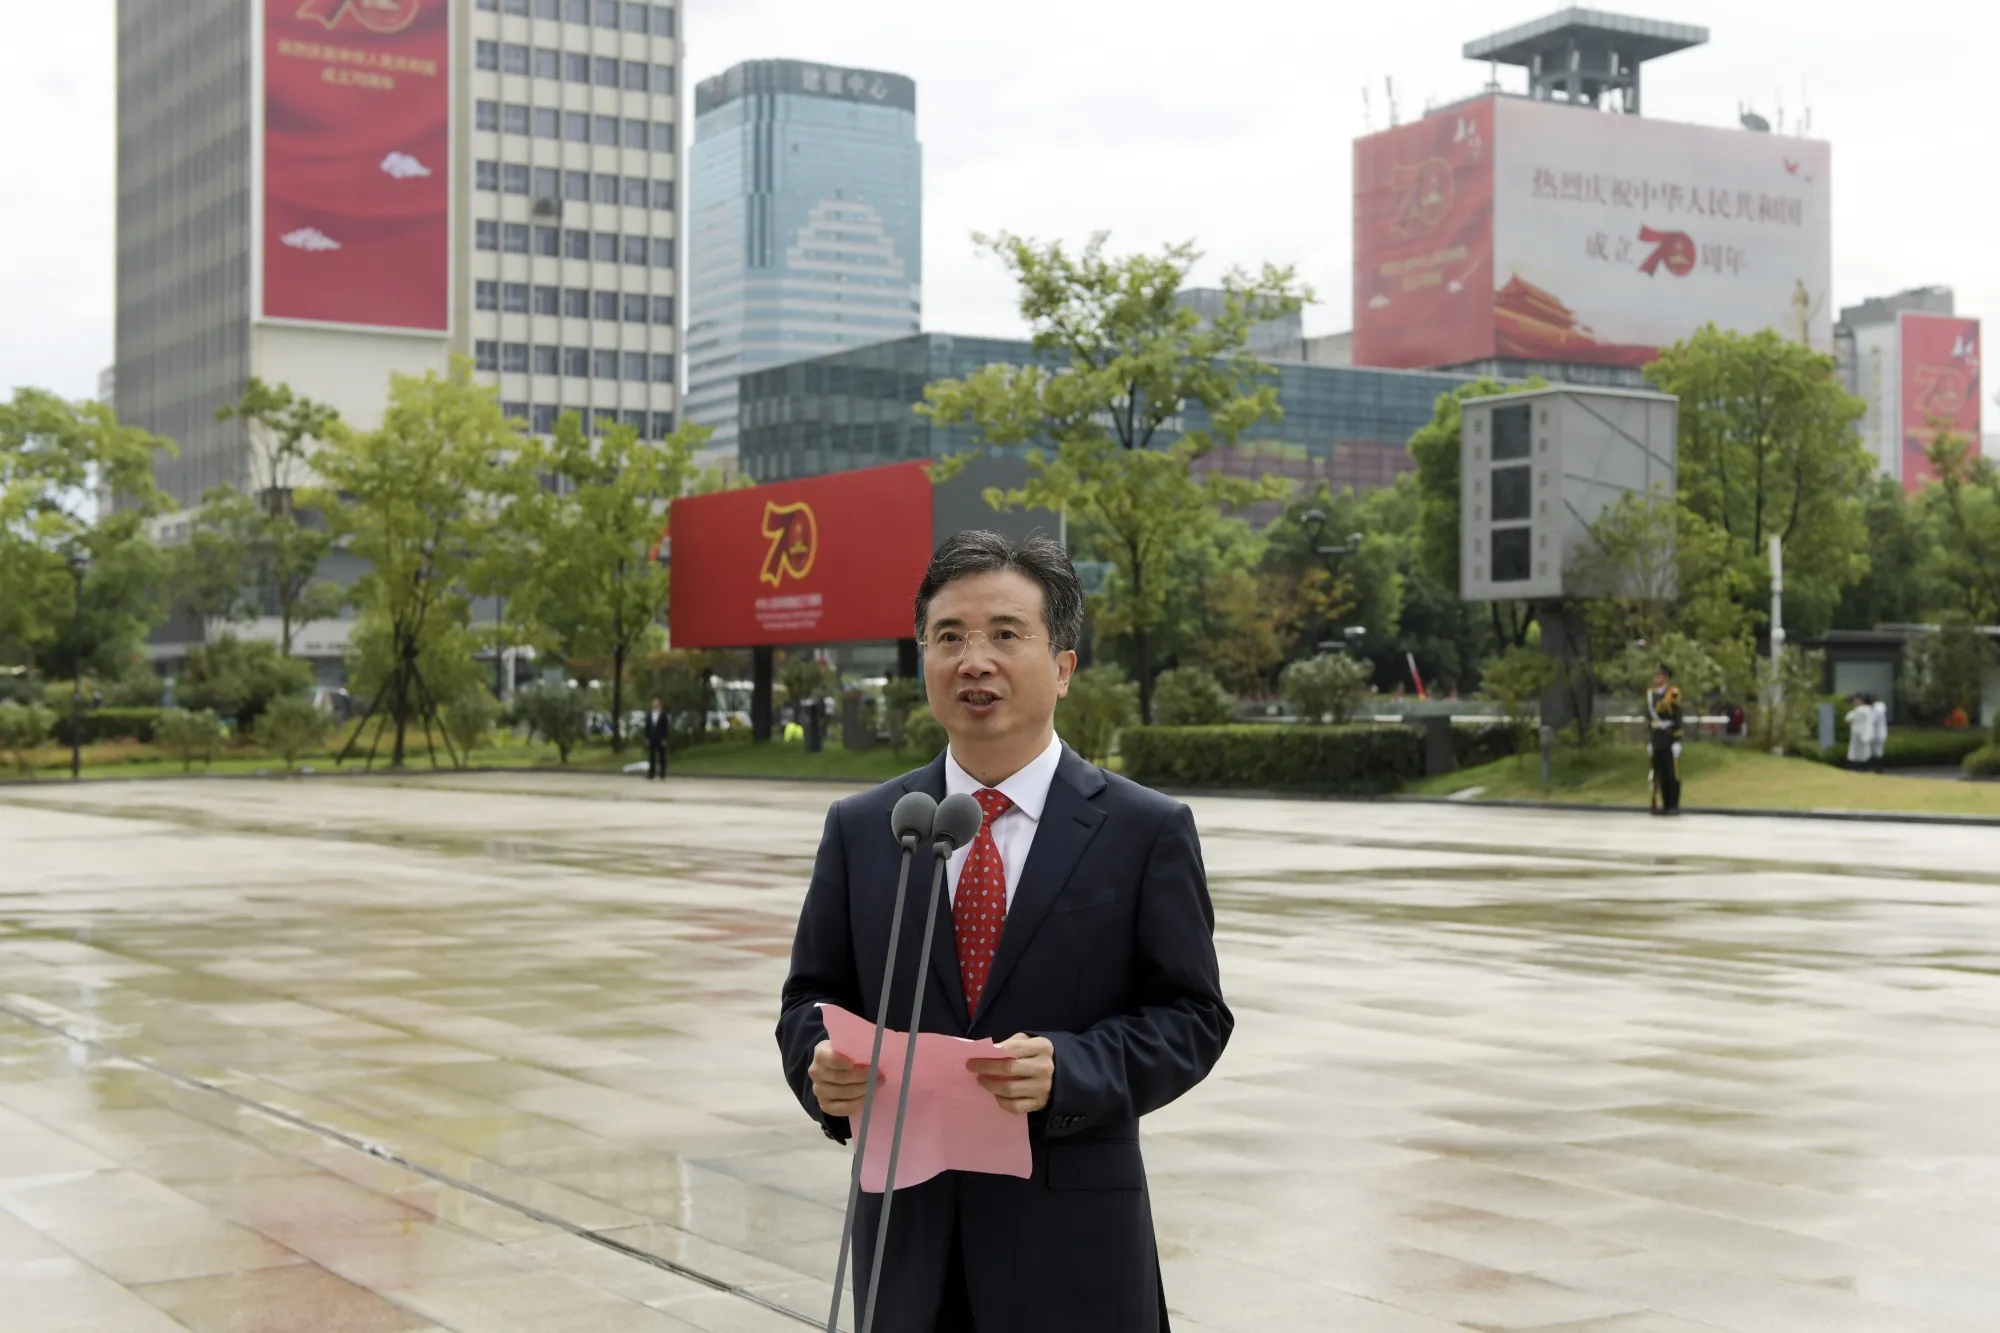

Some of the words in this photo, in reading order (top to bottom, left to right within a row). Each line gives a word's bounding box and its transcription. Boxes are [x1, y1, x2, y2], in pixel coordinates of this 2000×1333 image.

[1531, 167, 1803, 227] 热烈庆祝中华人民共和国
[760, 500, 818, 589] 70
